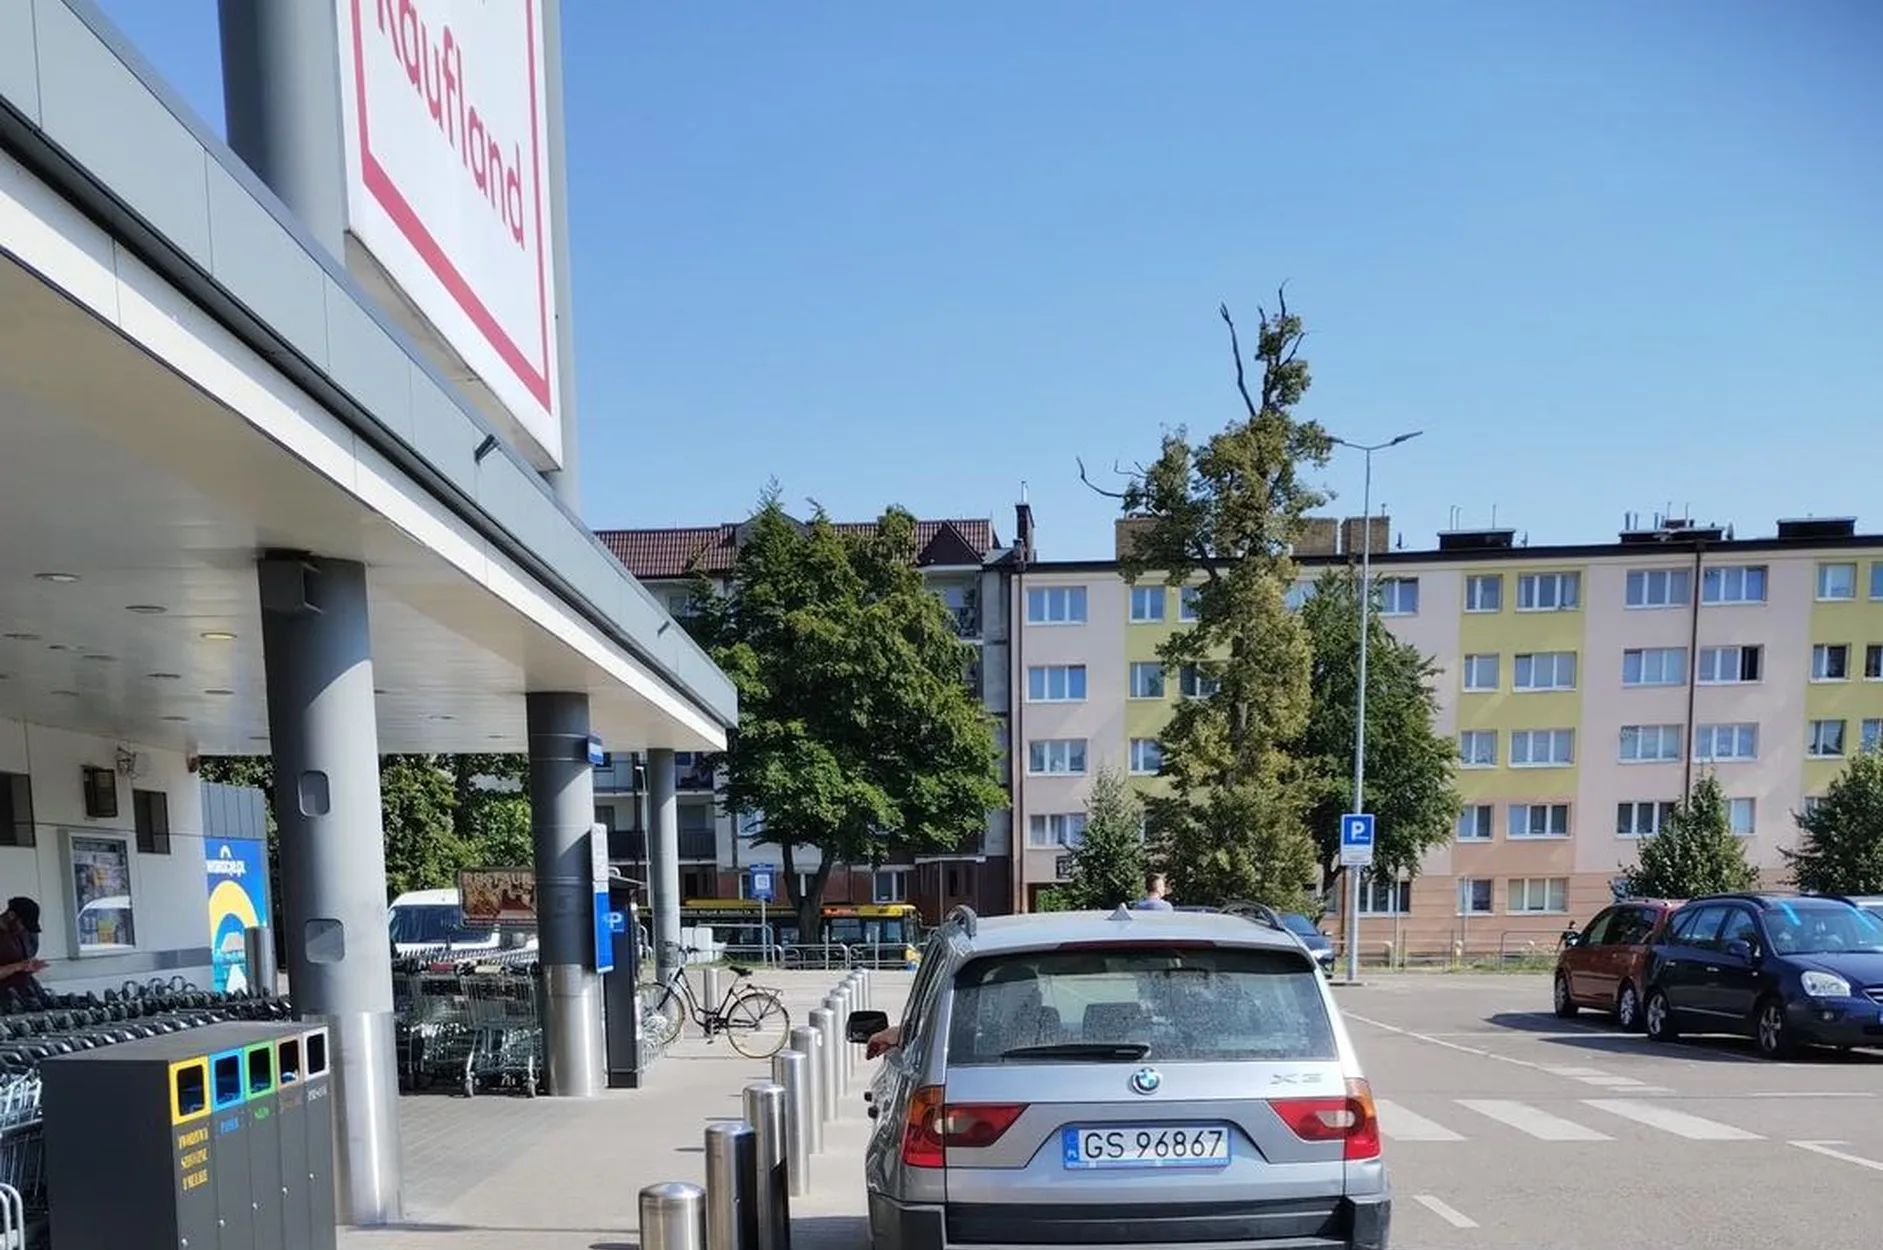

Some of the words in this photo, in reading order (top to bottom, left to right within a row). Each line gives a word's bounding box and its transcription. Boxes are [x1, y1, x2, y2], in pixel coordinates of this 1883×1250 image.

[1352, 821, 1365, 840] P
[1085, 1132, 1124, 1159] GS
[1136, 1130, 1223, 1158] 96867
